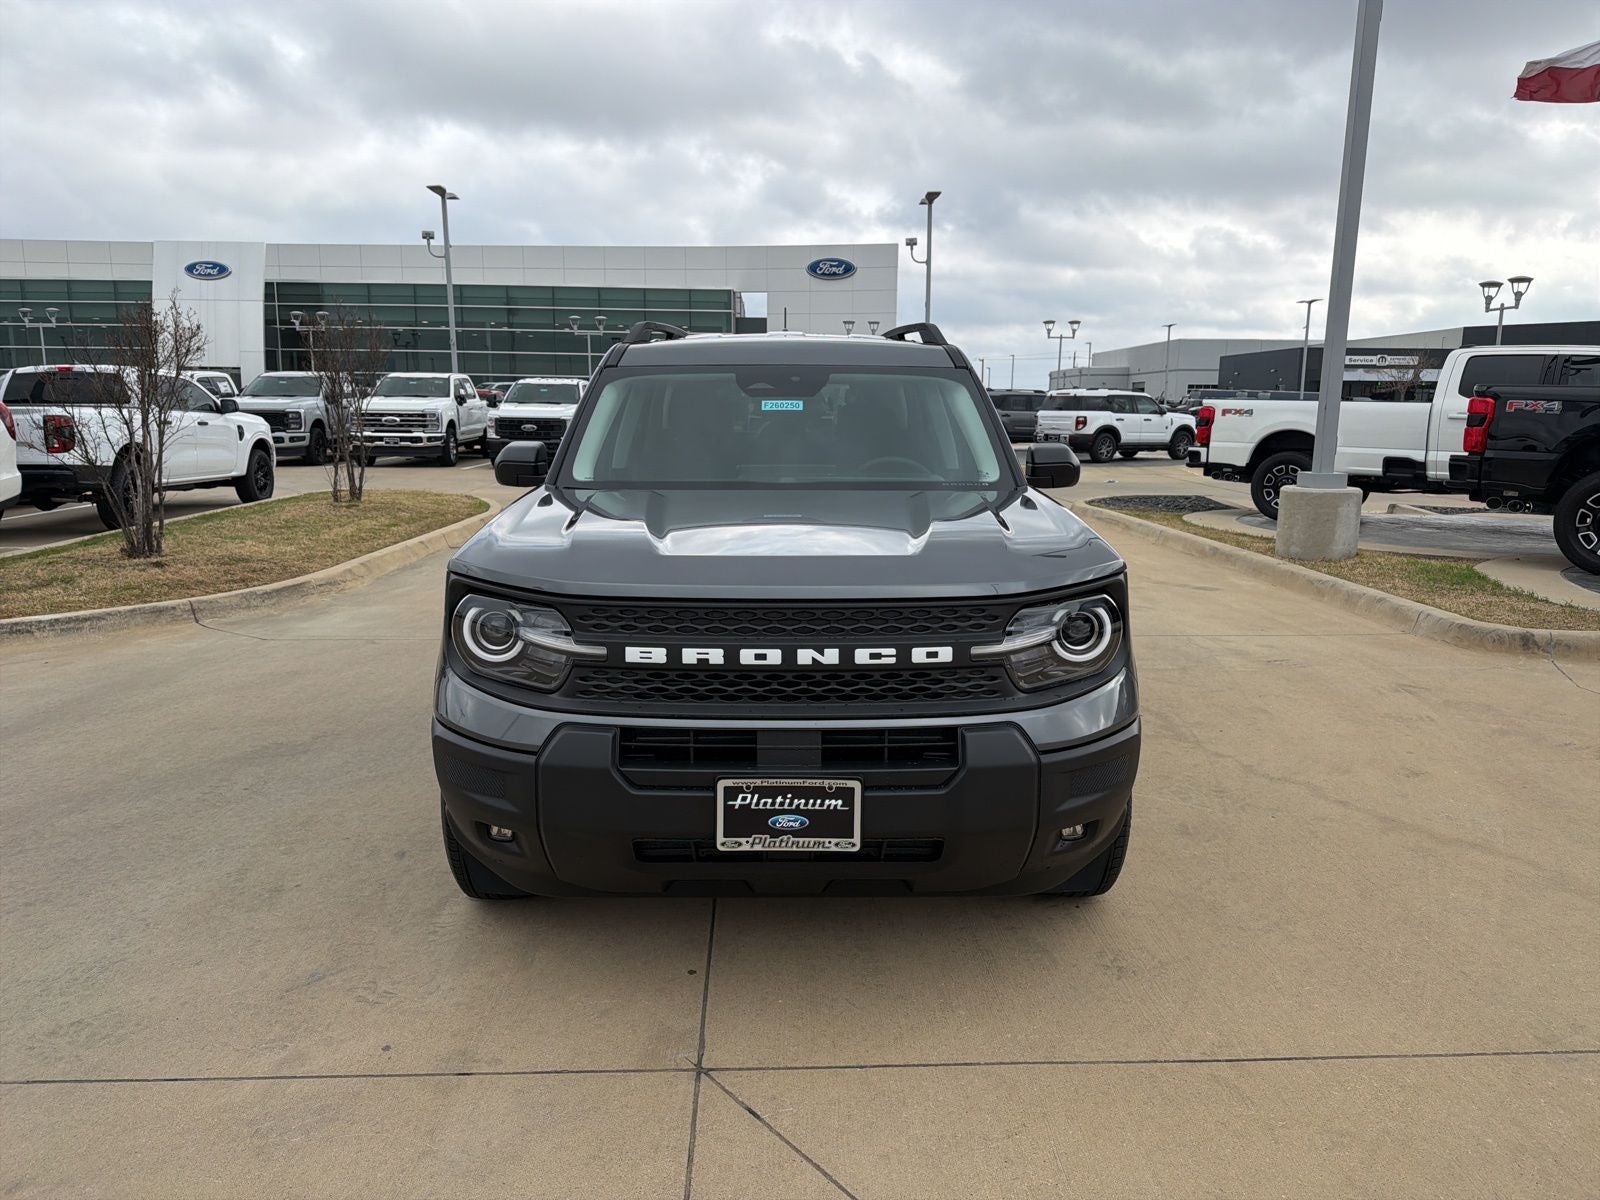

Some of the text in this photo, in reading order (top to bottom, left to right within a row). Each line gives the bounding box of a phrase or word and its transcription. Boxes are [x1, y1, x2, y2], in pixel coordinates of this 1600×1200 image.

[193, 263, 220, 275] Ford
[816, 260, 846, 275] Ford
[764, 401, 801, 409] F260250
[1506, 400, 1563, 414] FX4
[1221, 408, 1254, 417] FX4
[625, 646, 953, 665] BRONCO
[731, 779, 849, 787] www.PlatinumFord.com
[727, 793, 850, 811] Platinum
[775, 816, 801, 828] Ford
[749, 834, 832, 850] Platinum
